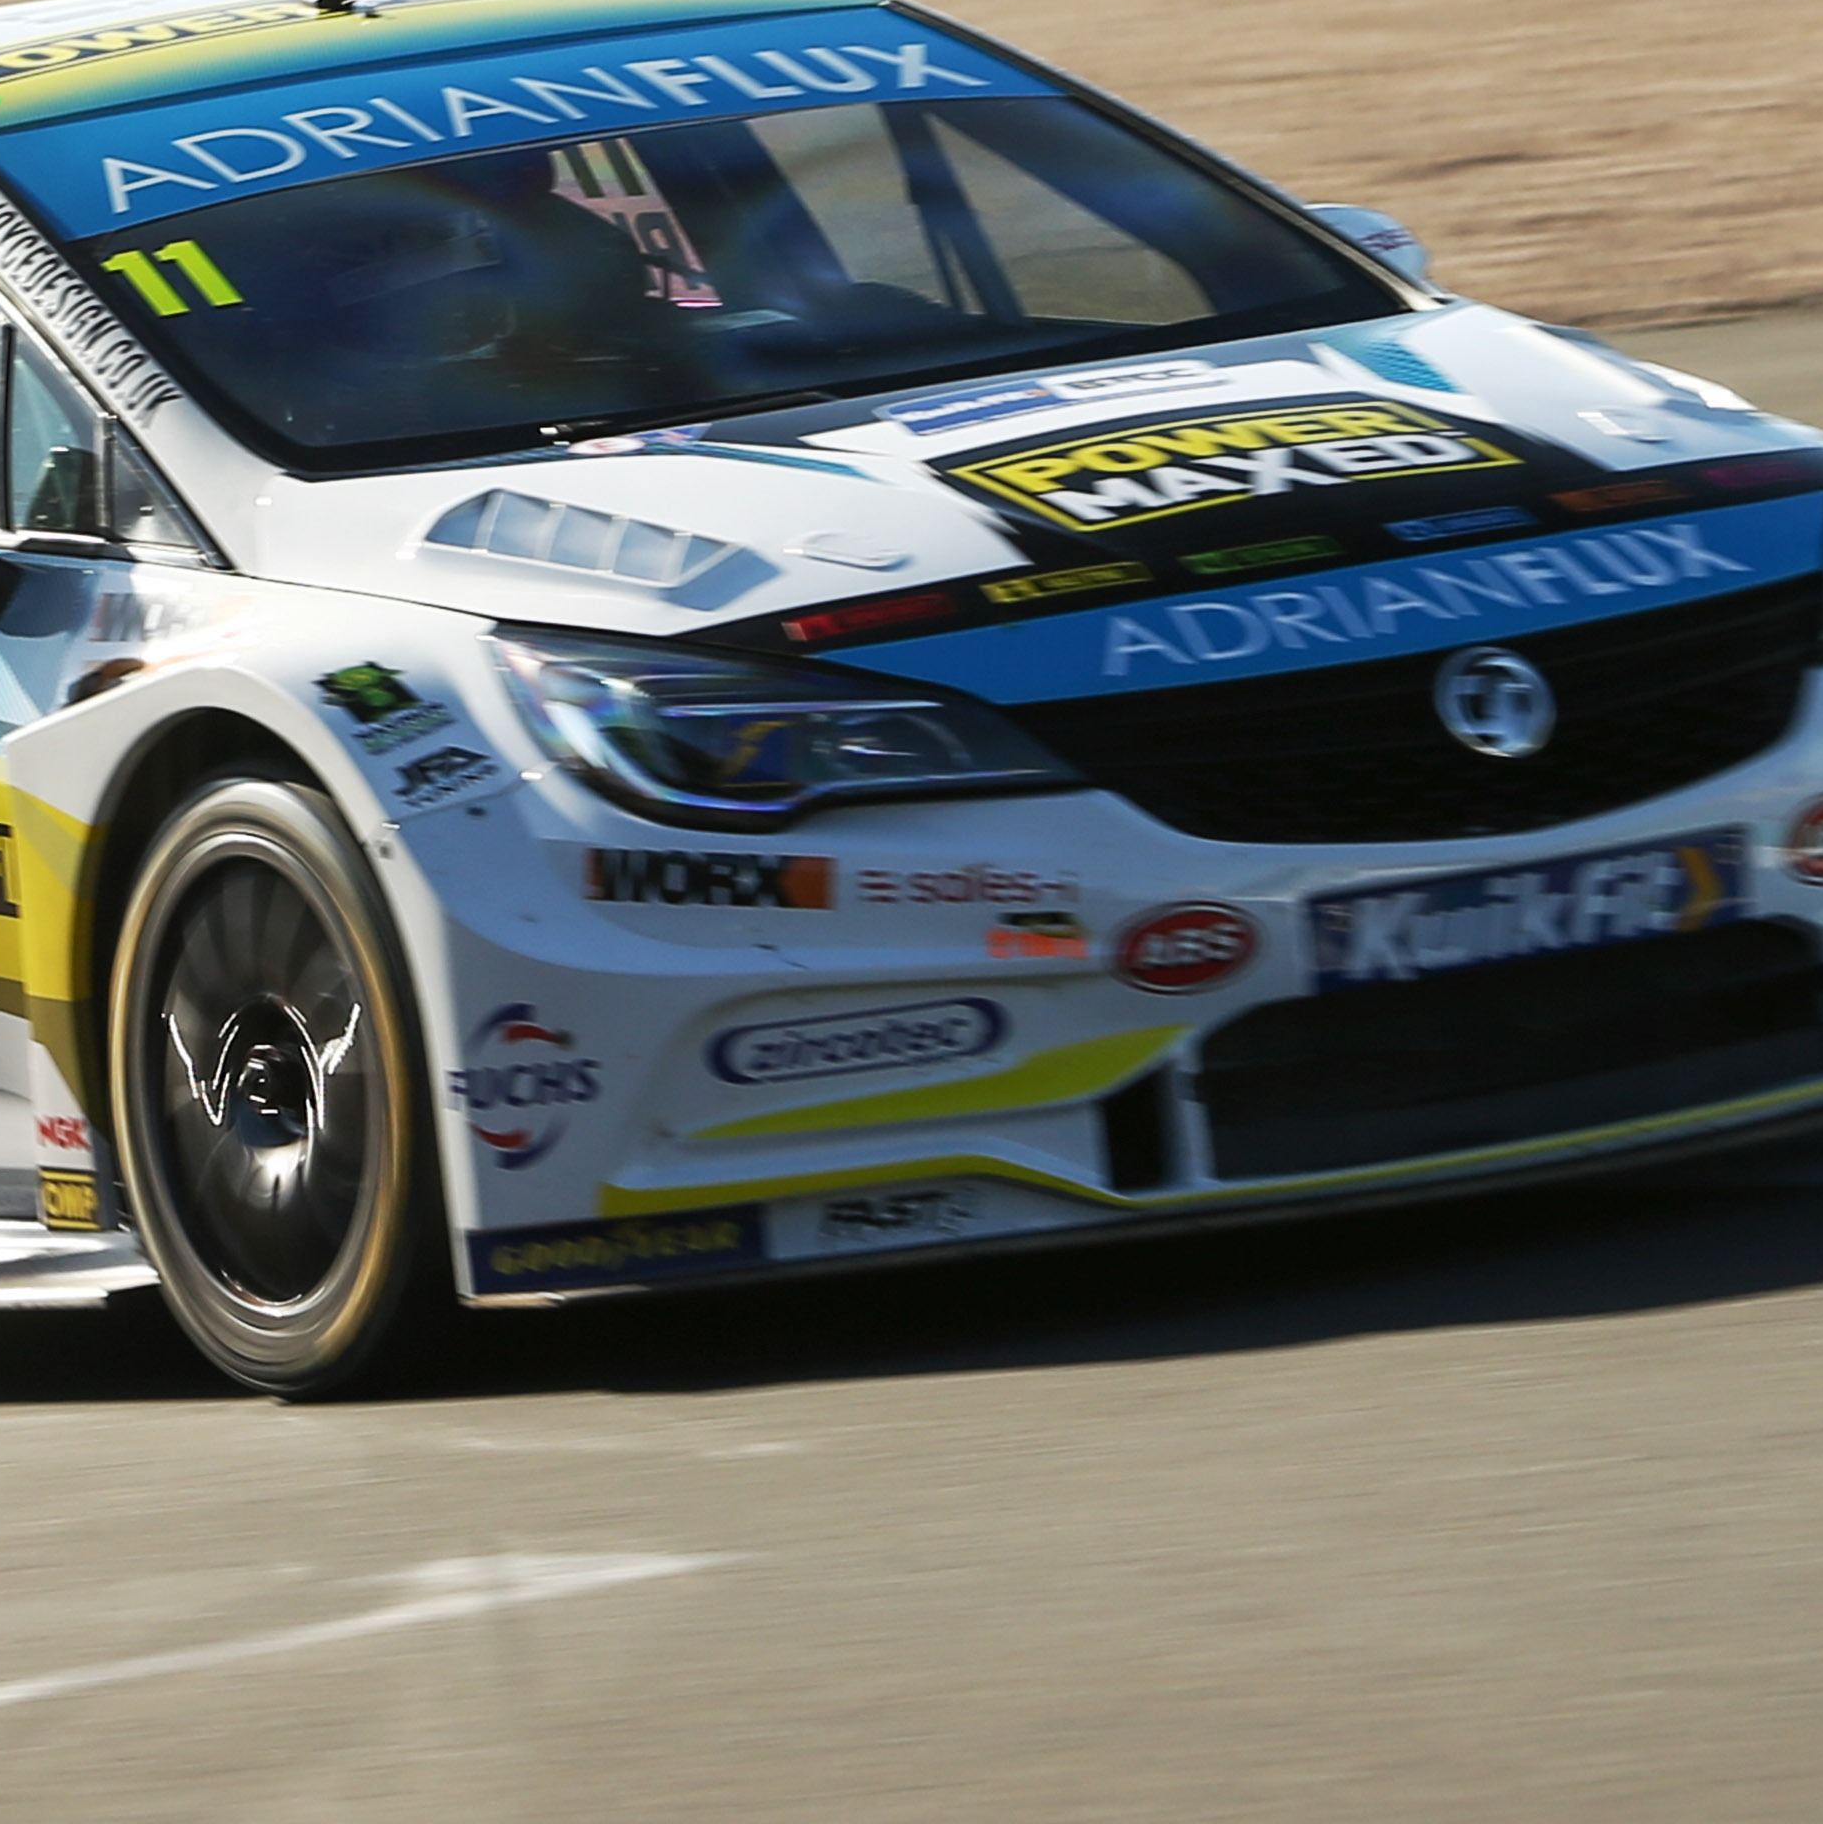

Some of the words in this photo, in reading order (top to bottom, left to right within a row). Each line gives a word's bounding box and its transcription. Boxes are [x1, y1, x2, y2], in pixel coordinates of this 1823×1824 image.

[101, 42, 991, 214] ADRIANFLUX
[102, 238, 244, 318] 11
[985, 410, 1406, 495] POWER
[1039, 432, 1477, 523] MAXED
[1101, 523, 1754, 676] ADRIANFLUX
[601, 849, 784, 908] WORX
[907, 862, 1081, 905] sales-i
[747, 1016, 973, 1073] zircotec
[449, 1057, 602, 1110] FUCHS
[42, 1180, 99, 1221] OMP
